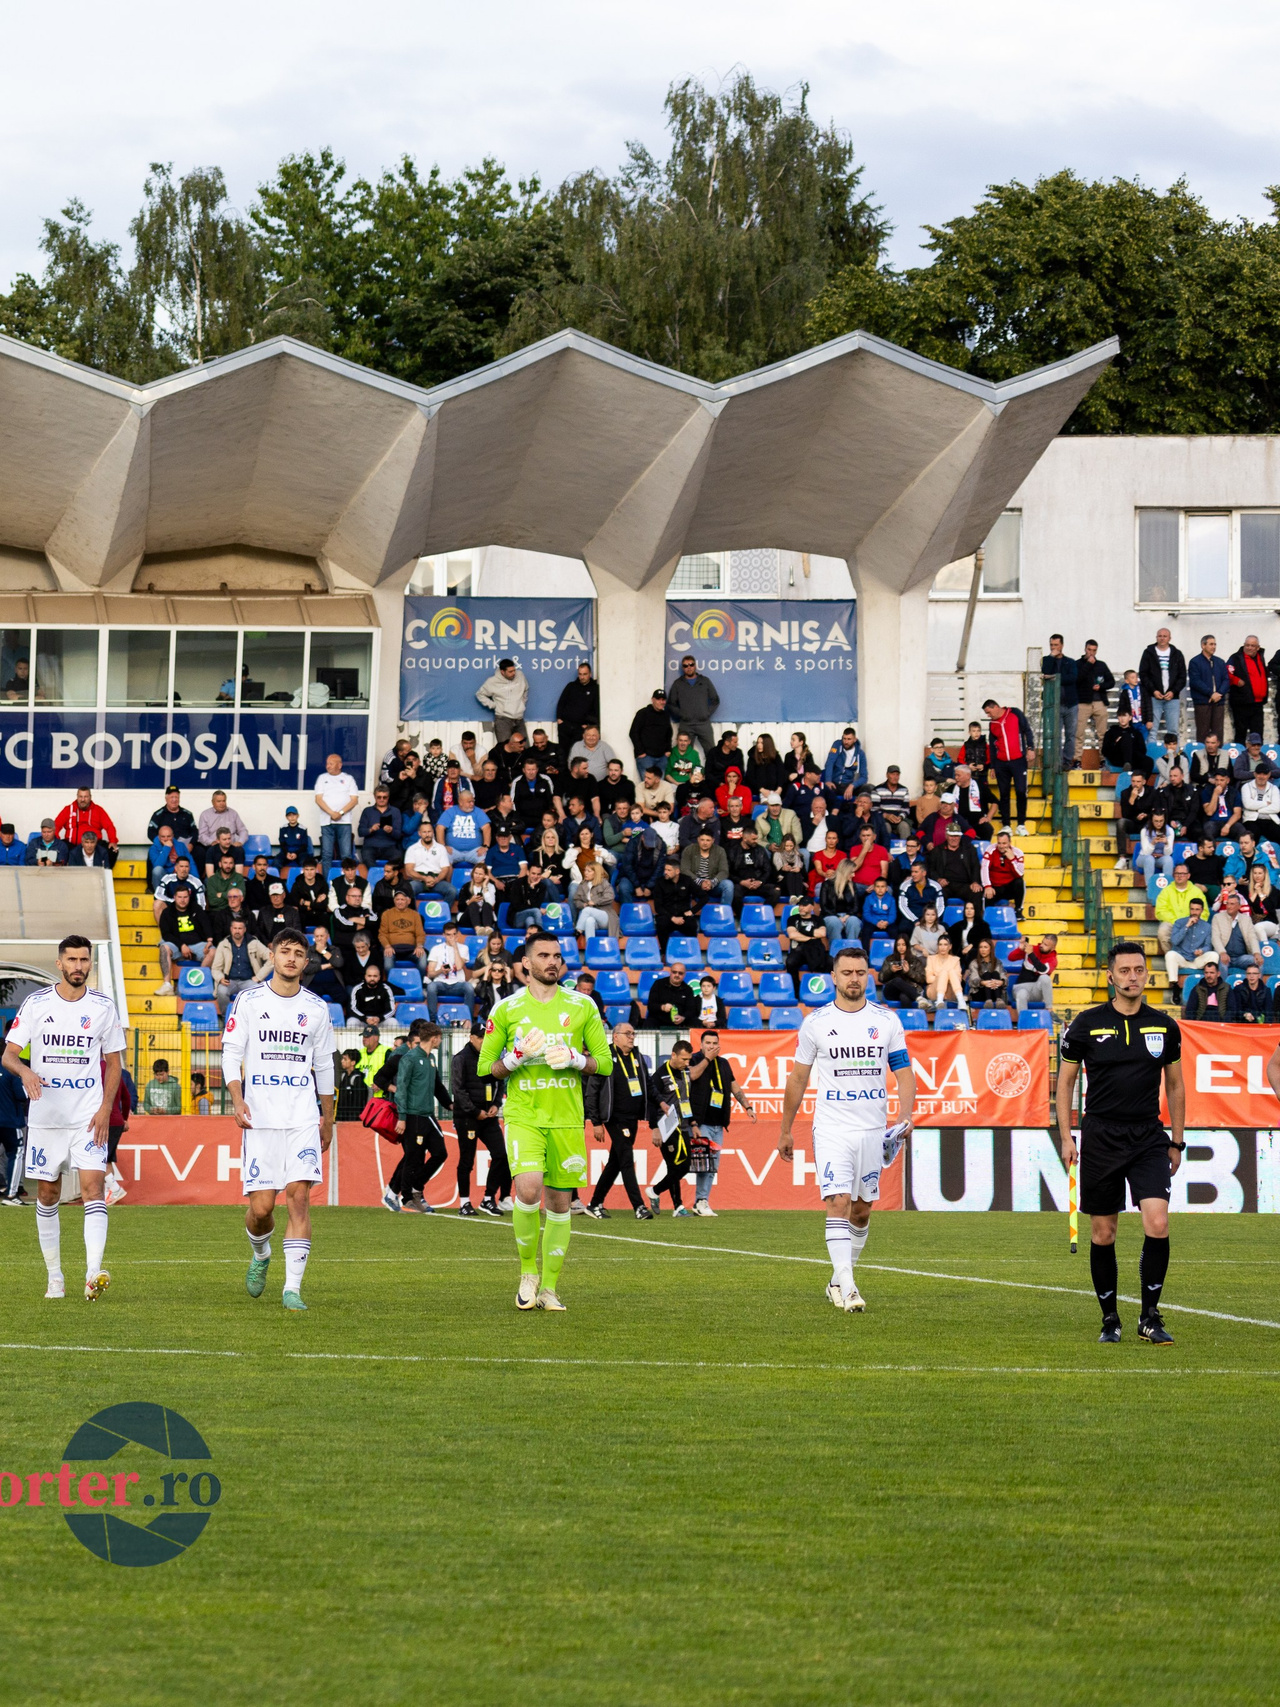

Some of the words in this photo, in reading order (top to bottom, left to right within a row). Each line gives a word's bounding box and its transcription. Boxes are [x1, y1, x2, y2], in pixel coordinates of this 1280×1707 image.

[404, 655, 499, 673] aquapark
[512, 656, 523, 669] &
[668, 656, 766, 673] auapark
[774, 656, 786, 670] &
[796, 656, 854, 674] sports
[51, 731, 308, 779] BOTOȘANI
[1094, 804, 1102, 817] 9
[128, 865, 135, 877] 7
[1125, 906, 1134, 919] 6
[135, 931, 143, 944] 5
[139, 965, 147, 978] 4
[1148, 974, 1156, 987] 4
[145, 1000, 152, 1013] 3
[42, 1034, 94, 1048] UNIBET
[148, 1034, 155, 1047] 2
[258, 1030, 308, 1045] UNIBET
[829, 1046, 884, 1059] UNIBET
[252, 1074, 309, 1087] ELSACO
[519, 1077, 577, 1091] ELSACO
[826, 1089, 885, 1101] ELSACO
[942, 1100, 977, 1115] BUN
[31, 1146, 47, 1167] 16
[512, 1140, 519, 1160] 1
[249, 1157, 260, 1178] 6
[823, 1161, 834, 1181] 4
